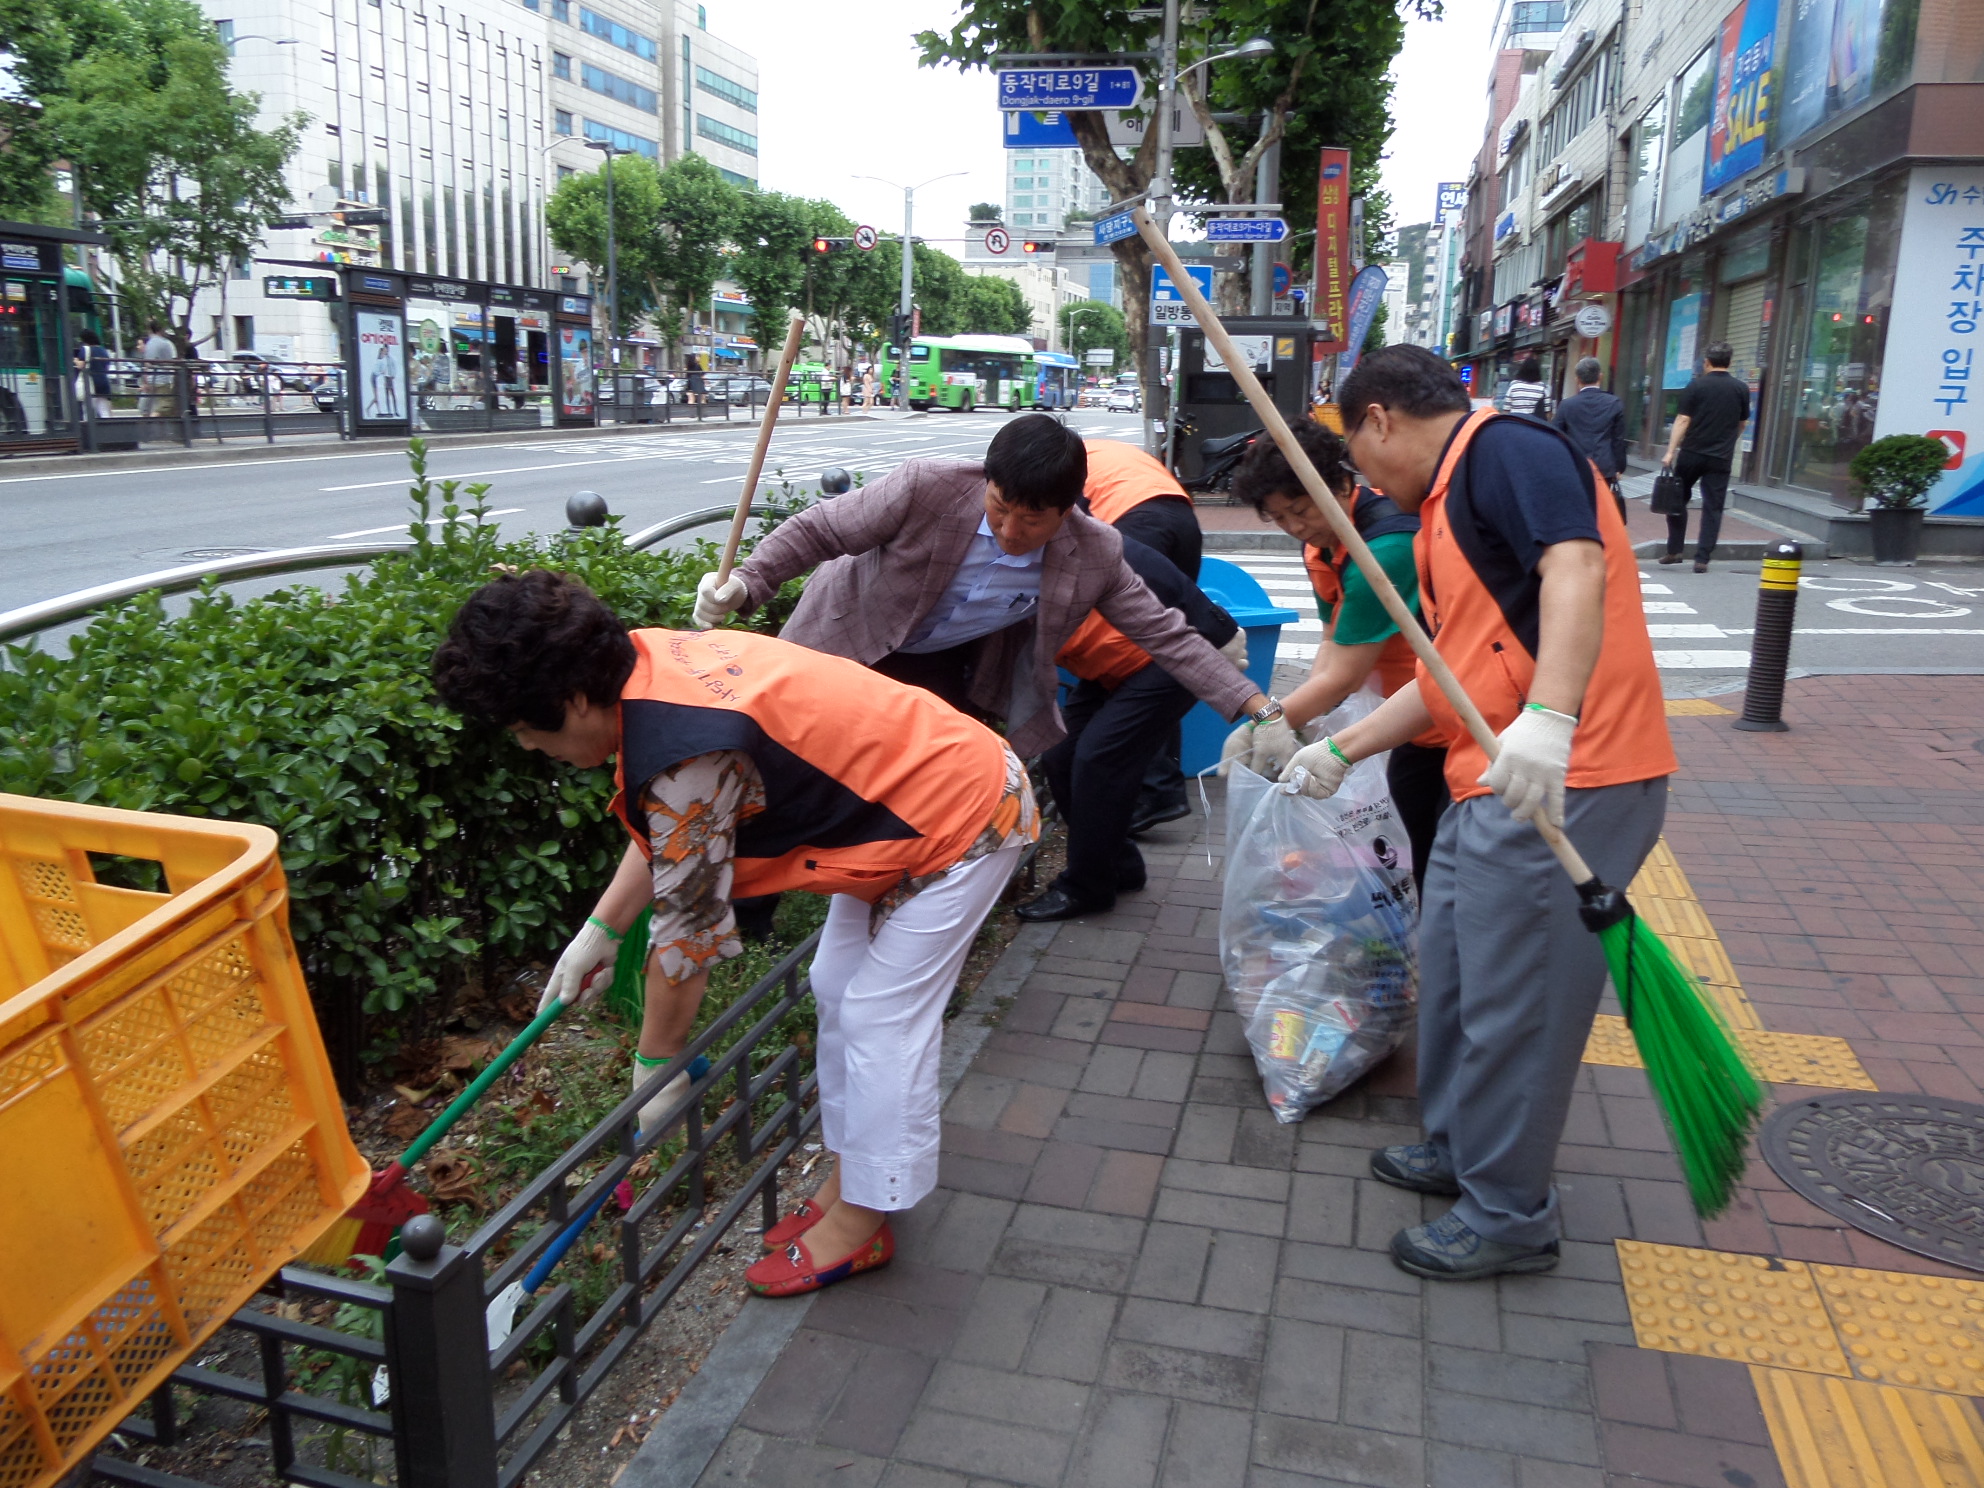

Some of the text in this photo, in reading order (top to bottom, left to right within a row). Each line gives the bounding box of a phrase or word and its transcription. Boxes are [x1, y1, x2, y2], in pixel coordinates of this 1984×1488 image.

[1002, 72, 1099, 94] 동작대로9길
[1002, 95, 1095, 107] Dongjak-daero 9-gil
[1724, 70, 1771, 156] SALE
[1925, 182, 1959, 205] Sh
[1946, 227, 1984, 334] 주차장
[1155, 305, 1192, 321] 일방통
[1933, 348, 1974, 416] 입구
